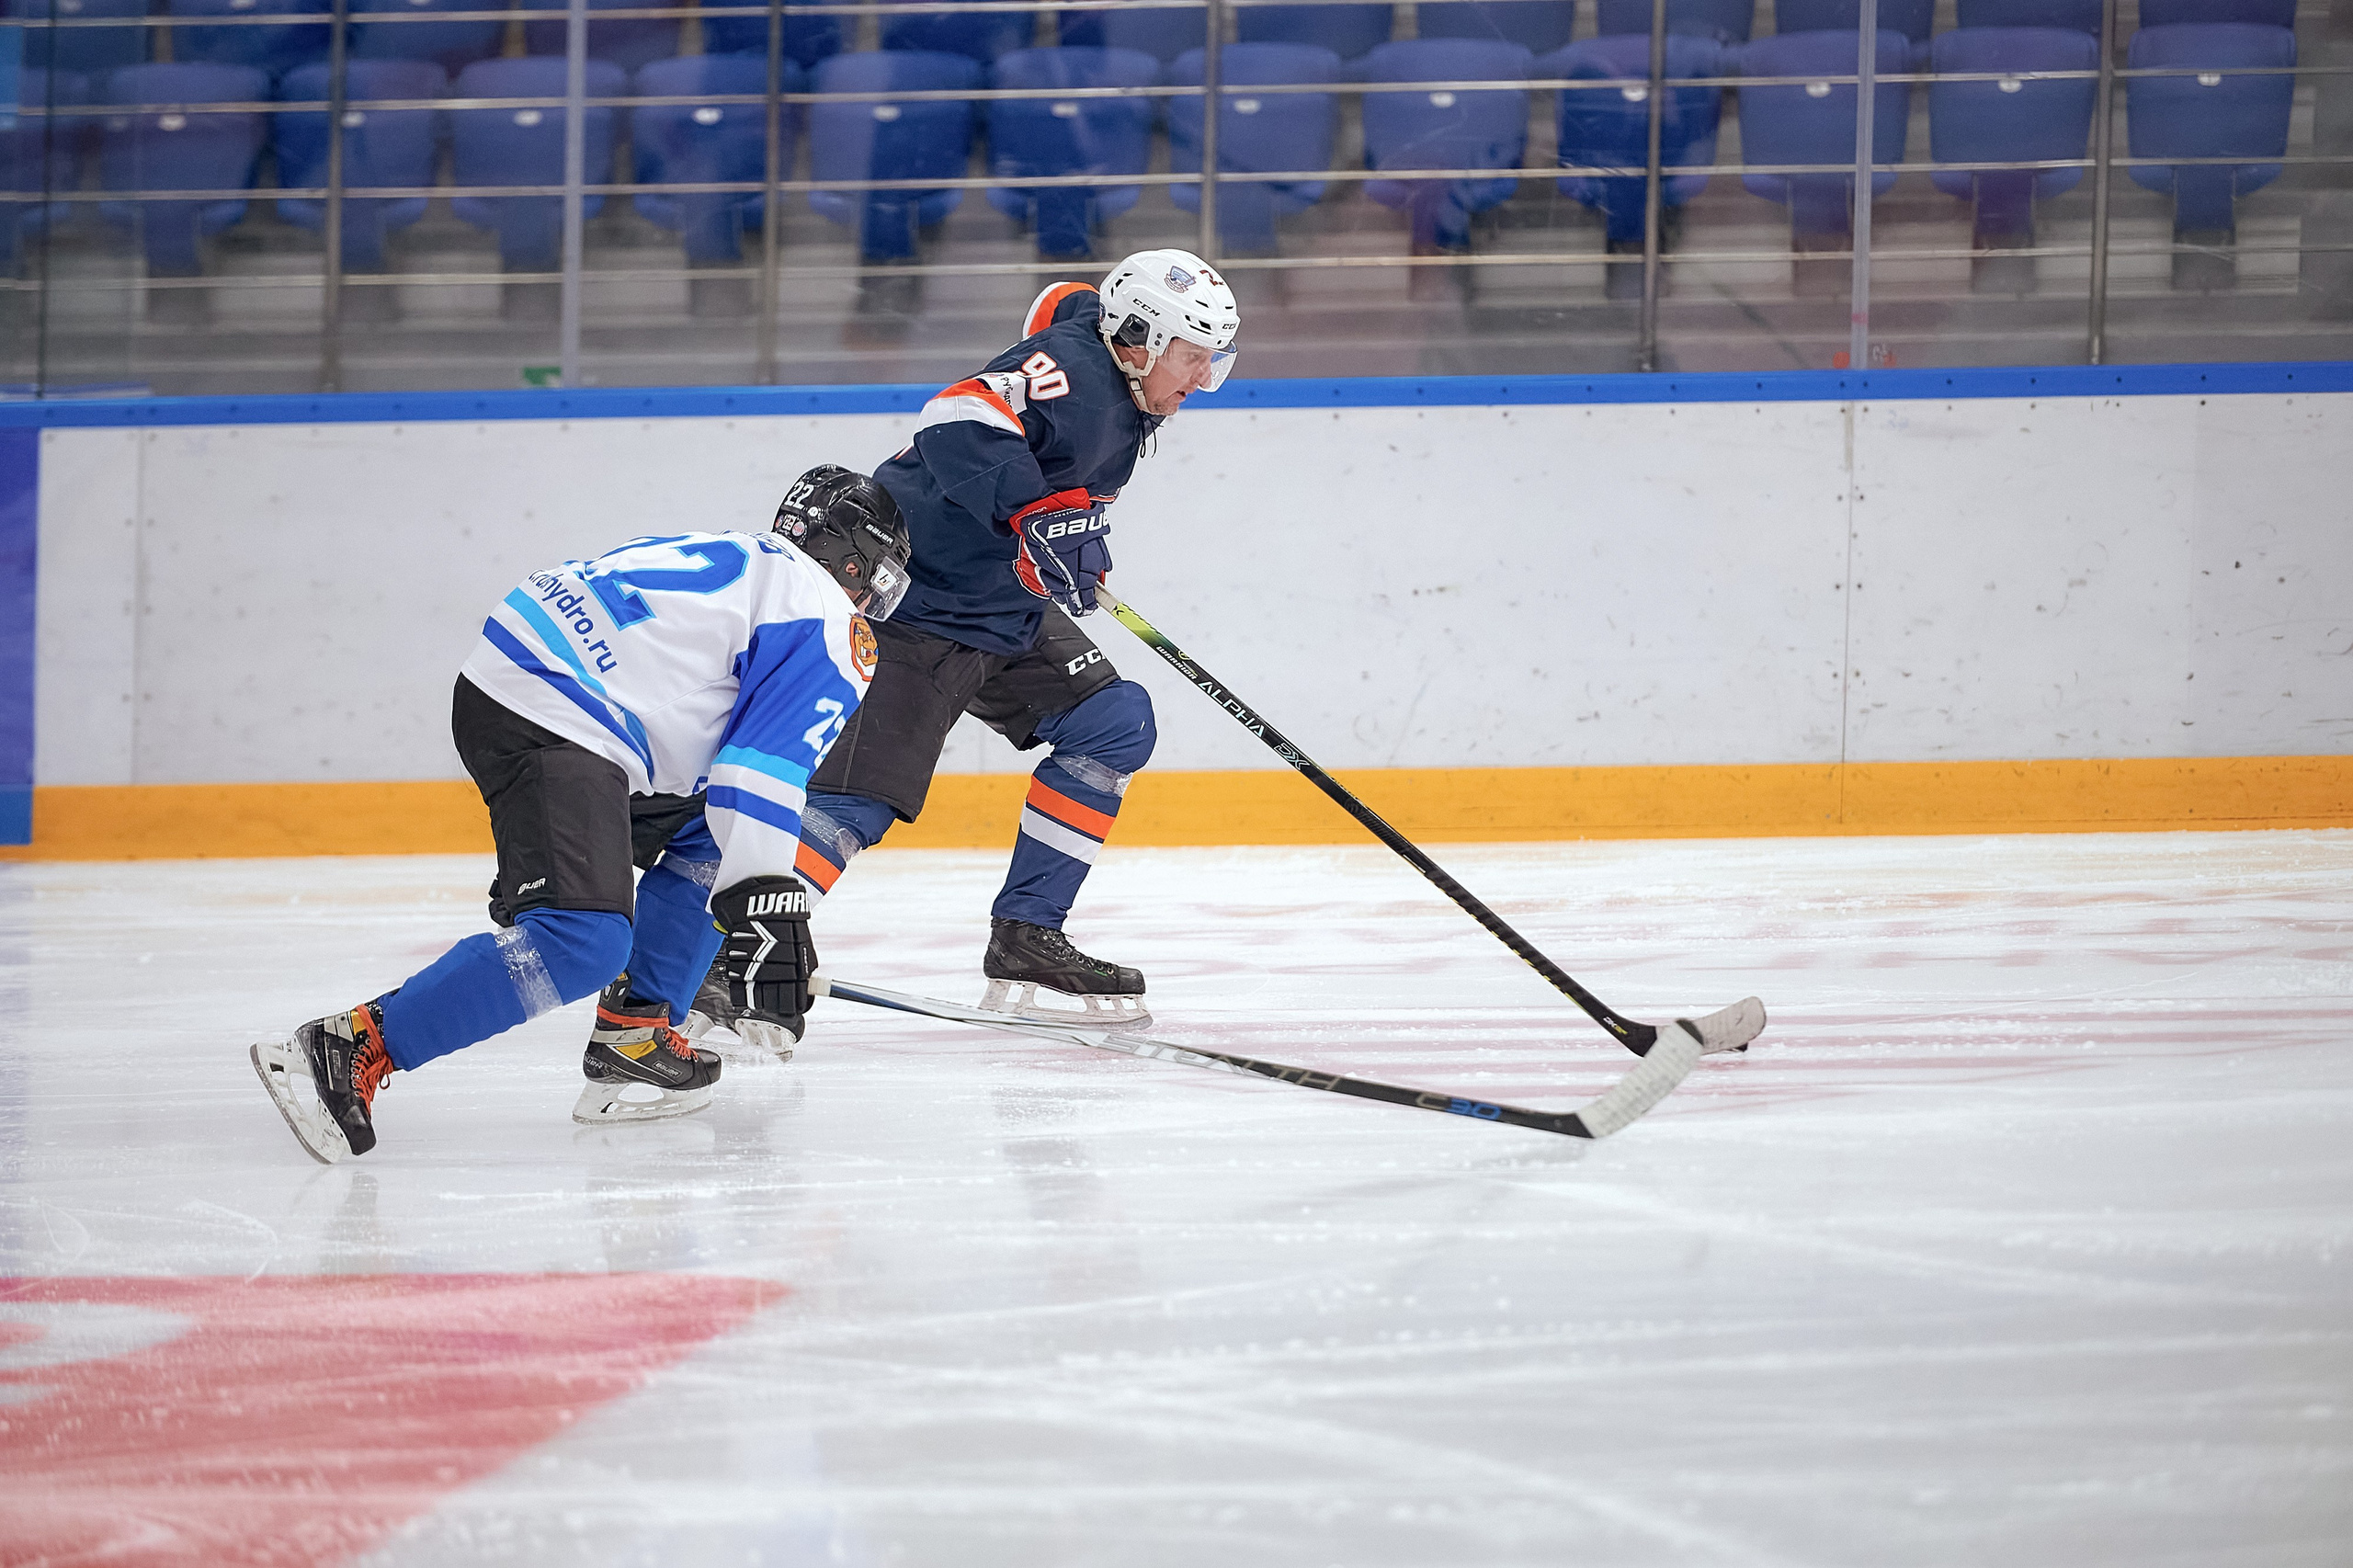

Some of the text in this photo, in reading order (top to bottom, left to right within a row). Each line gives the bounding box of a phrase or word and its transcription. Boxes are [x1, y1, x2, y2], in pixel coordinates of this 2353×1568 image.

[1132, 298, 1161, 317] CCM
[1015, 350, 1071, 401] 90
[783, 480, 815, 510] 22
[864, 522, 894, 546] BAUER
[1064, 648, 1106, 676] CC
[1155, 645, 1312, 771] WARRIOR ALPHA DX
